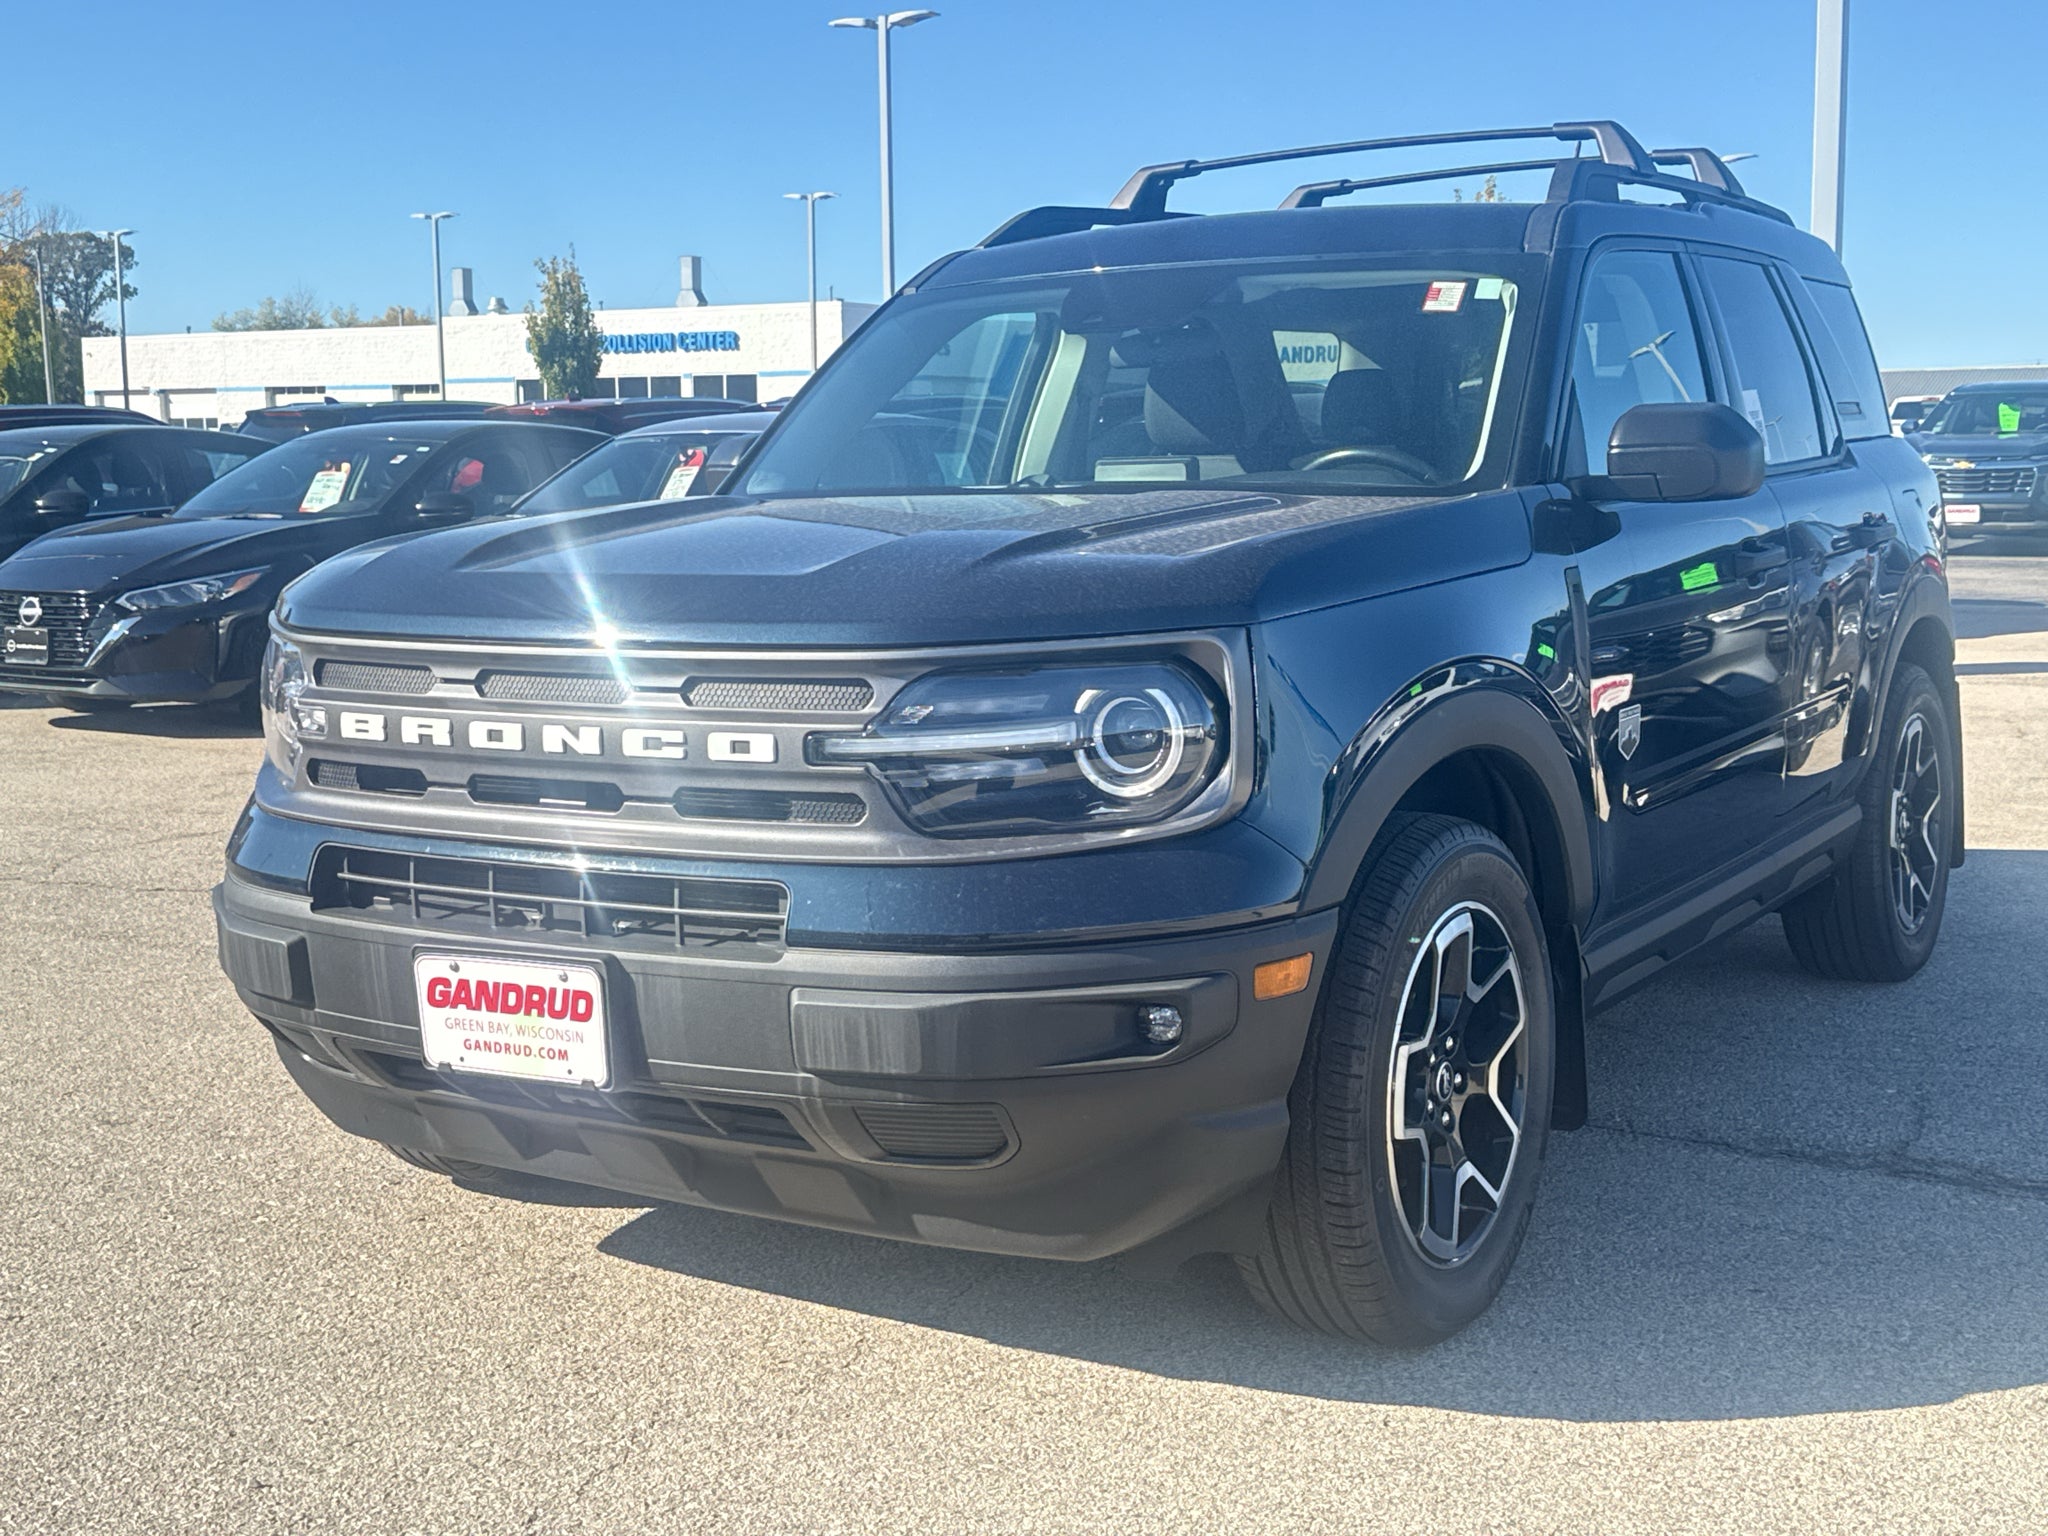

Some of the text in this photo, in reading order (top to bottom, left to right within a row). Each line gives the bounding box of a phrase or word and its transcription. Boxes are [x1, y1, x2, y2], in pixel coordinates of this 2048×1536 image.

[677, 331, 740, 351] CENTER
[340, 711, 777, 763] BRONCO
[427, 977, 593, 1022] GANDRUD
[445, 1017, 584, 1043] GREEN BAY, WISCONSIN
[463, 1038, 569, 1061] GANDRUD.COM
